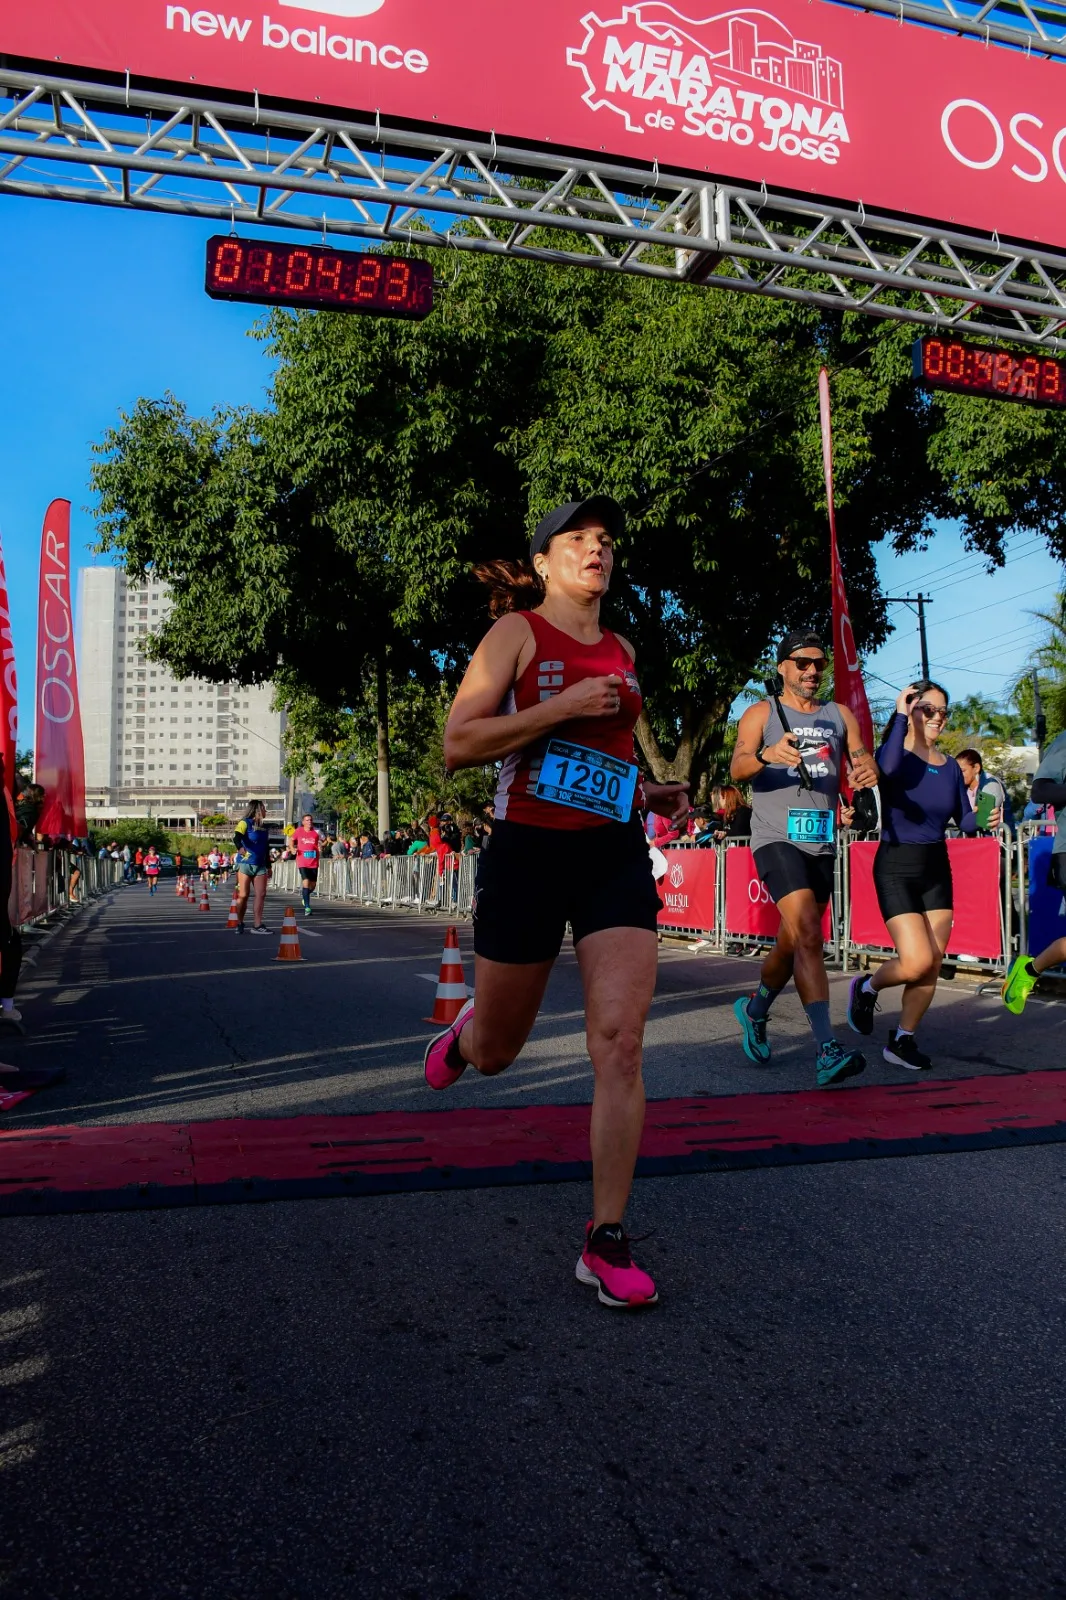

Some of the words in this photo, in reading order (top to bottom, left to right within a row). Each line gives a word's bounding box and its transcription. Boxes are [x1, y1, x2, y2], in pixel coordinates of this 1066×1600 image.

[165, 4, 252, 42] new
[262, 15, 429, 73] balance
[602, 35, 713, 87] MEIA
[605, 63, 850, 143] MARATONA
[644, 109, 676, 131] de
[681, 107, 754, 146] São
[758, 124, 840, 165] José
[940, 98, 1066, 184] OS
[41, 530, 75, 724] OSCAR
[790, 726, 834, 738] ORRe
[556, 760, 621, 802] 1290
[795, 818, 828, 833] 1078
